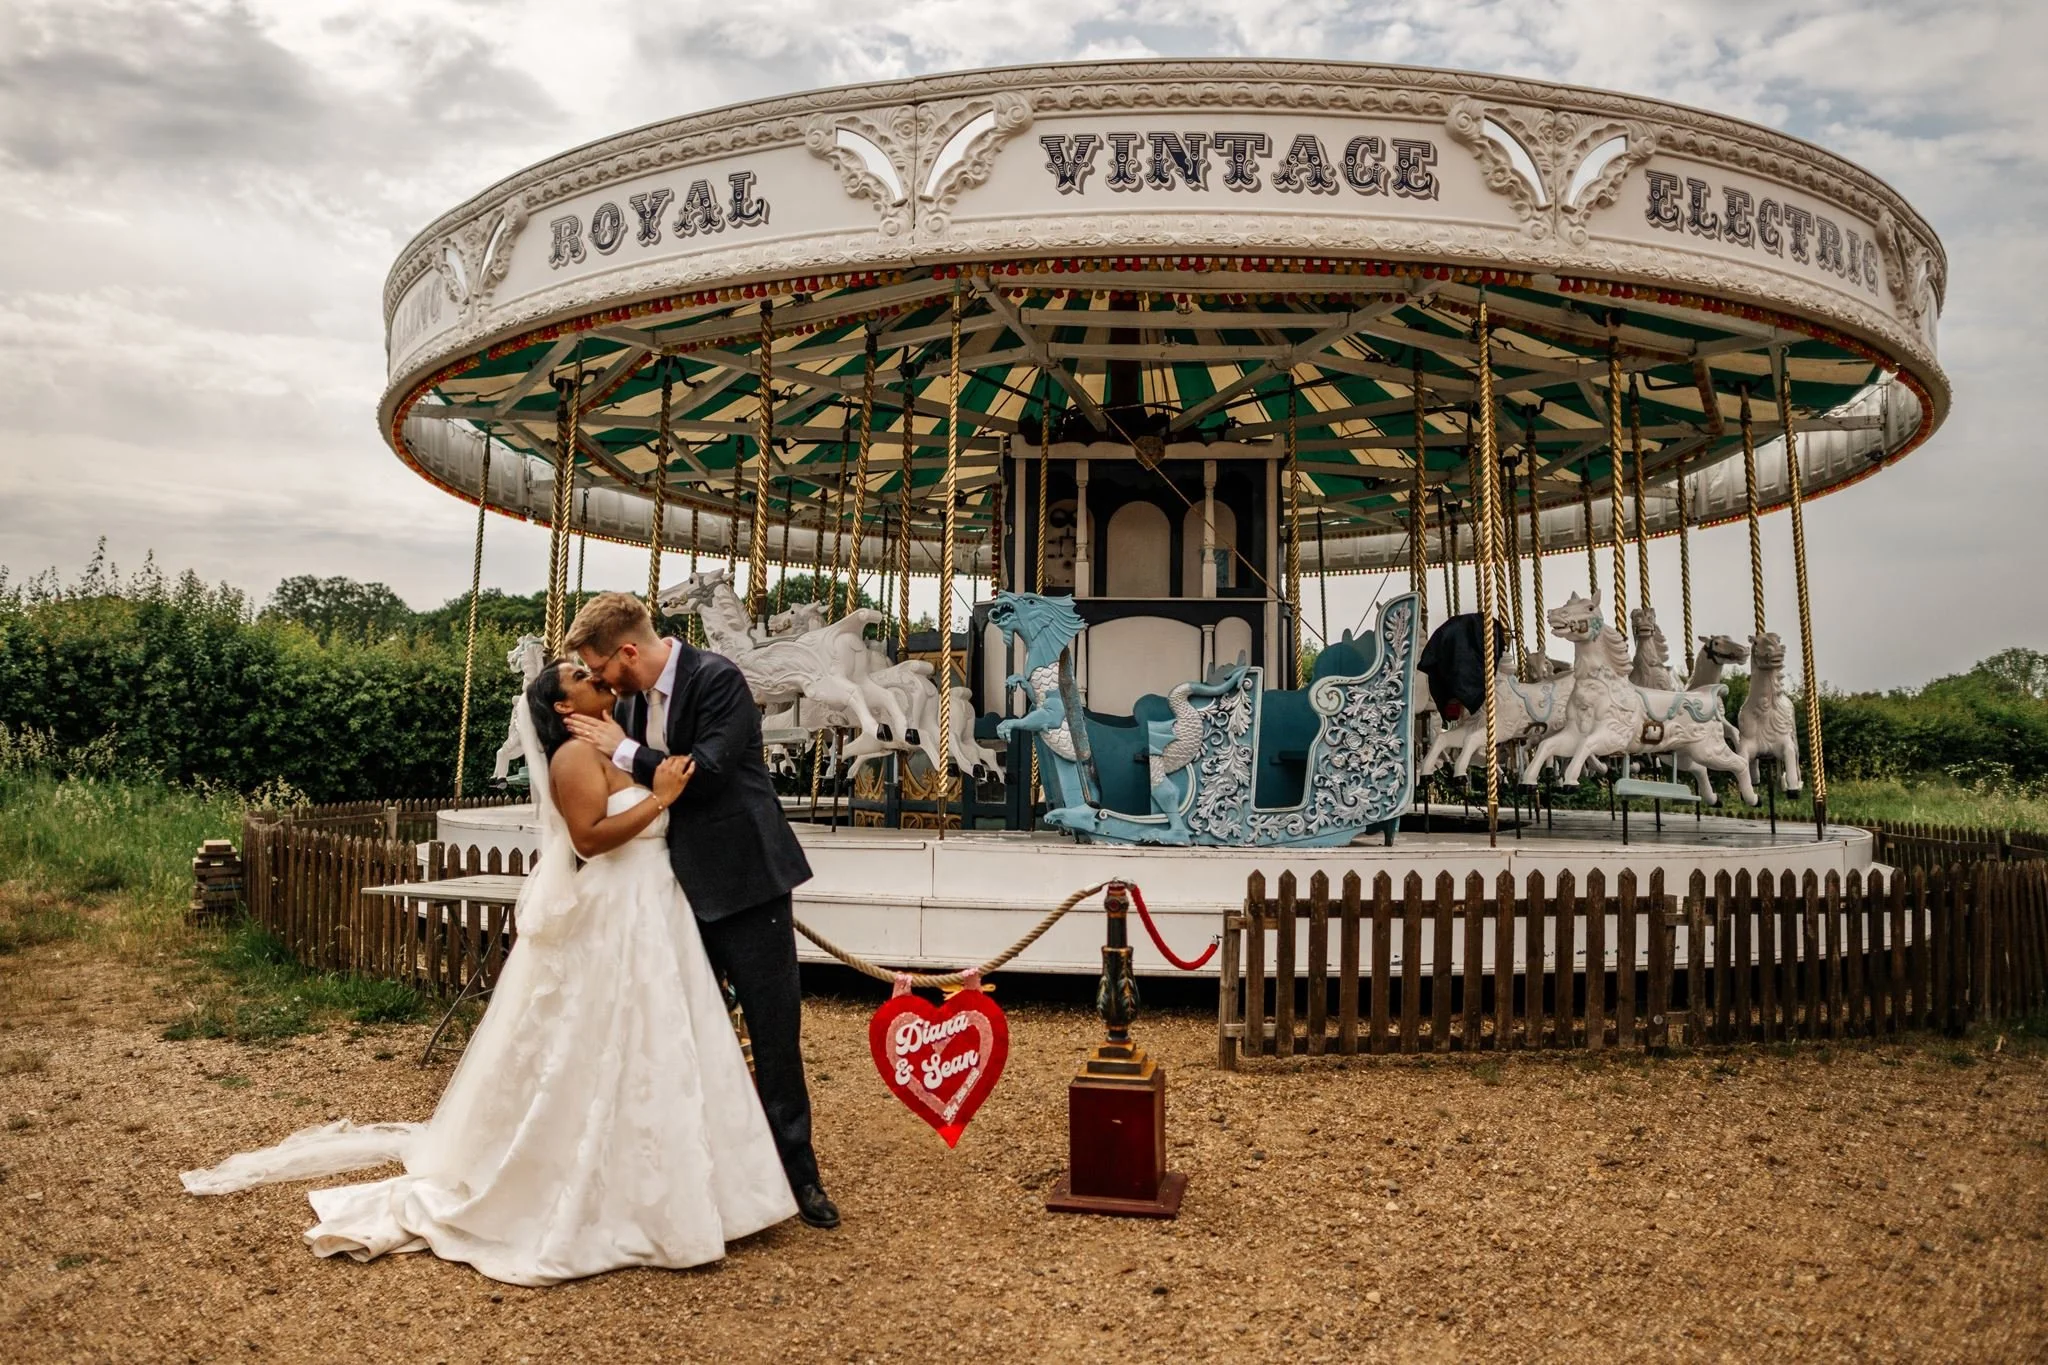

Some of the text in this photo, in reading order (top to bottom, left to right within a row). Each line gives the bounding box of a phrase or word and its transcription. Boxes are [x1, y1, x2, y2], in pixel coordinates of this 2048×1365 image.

[549, 131, 1879, 295] ROYAL VINTAGE ELECTRIC
[895, 1014, 968, 1055] Diana
[895, 1049, 979, 1089] & Sean
